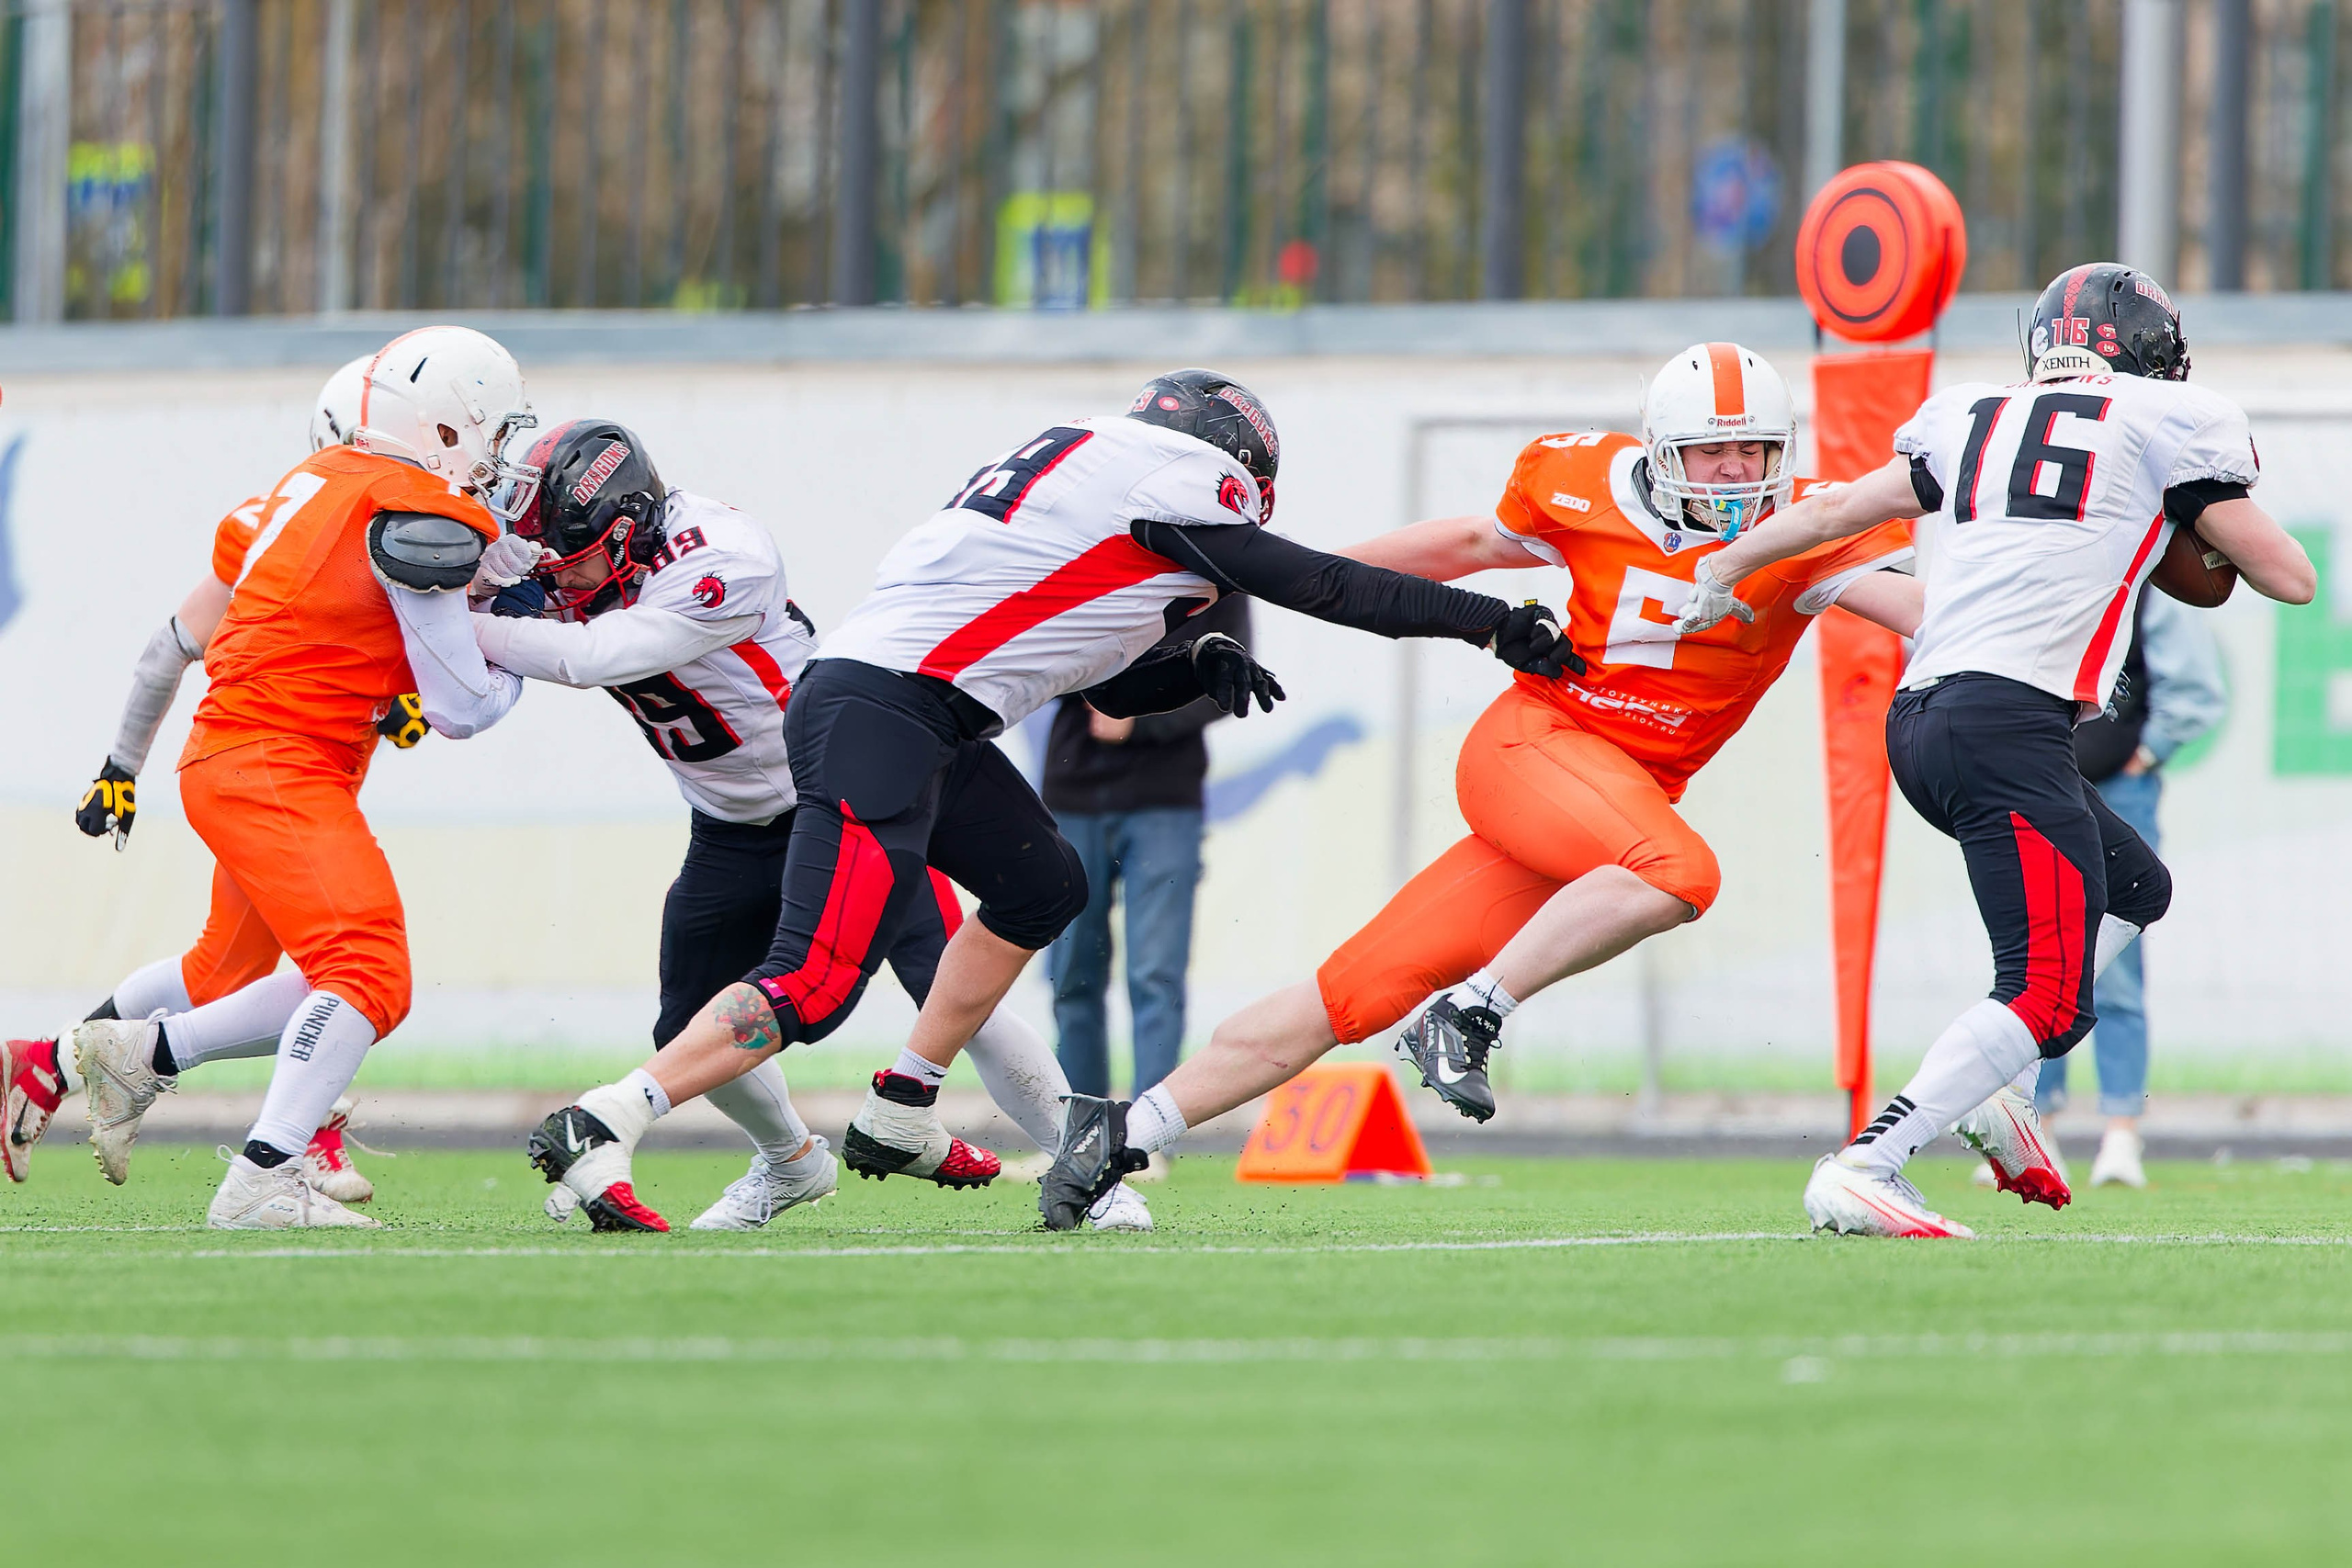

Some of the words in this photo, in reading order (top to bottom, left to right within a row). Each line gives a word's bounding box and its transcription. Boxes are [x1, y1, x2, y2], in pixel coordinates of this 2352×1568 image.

[2052, 318, 2090, 346] 16
[2042, 355, 2091, 371] XENITH
[1218, 385, 1279, 457] DRAGONS
[1717, 416, 1747, 427] Riddell
[572, 440, 632, 506] DRAGONS
[1954, 392, 2113, 524] 16
[1551, 492, 1591, 513] ZEDO
[231, 471, 328, 598] 7
[289, 996, 341, 1062] PUNCHER
[1072, 1124, 1101, 1155] ALPHA
